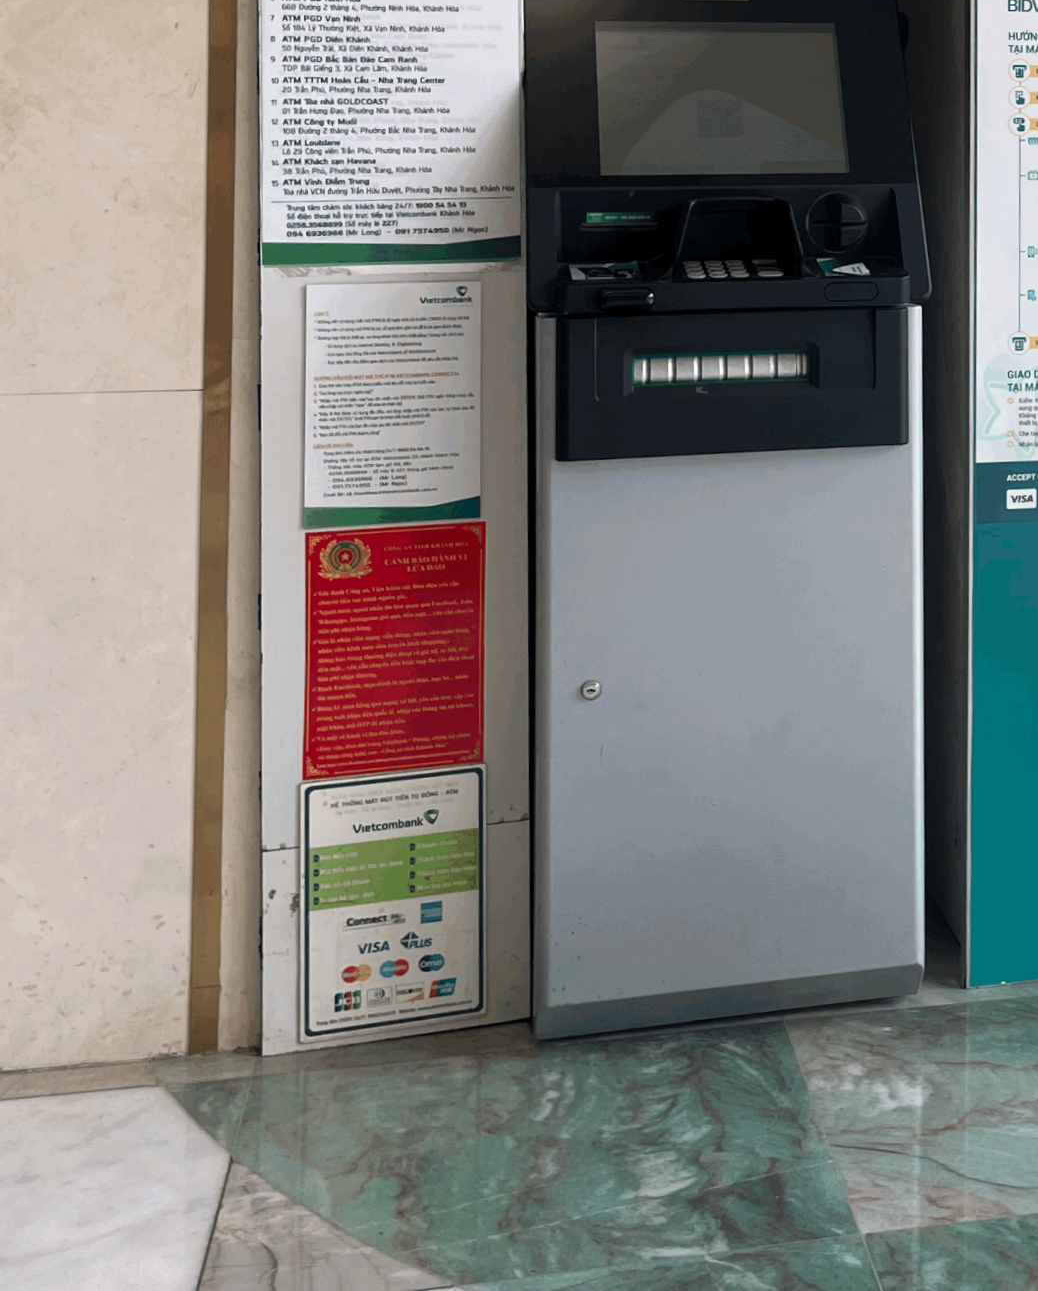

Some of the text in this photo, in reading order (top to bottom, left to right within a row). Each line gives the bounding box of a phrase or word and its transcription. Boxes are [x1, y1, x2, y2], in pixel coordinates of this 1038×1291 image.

[1008, 45, 1023, 54] TẠI
[331, 76, 352, 84] Hoàn
[397, 77, 417, 85] Trang
[349, 178, 369, 187] Trung
[420, 296, 472, 304] Vietcombank
[1007, 370, 1031, 380] GIAO
[1007, 383, 1022, 394] TẠI
[1007, 473, 1035, 481] ACCEPT
[1010, 495, 1034, 504] VISA
[353, 818, 423, 834] Vietcombank
[347, 915, 387, 927] Connect
[358, 941, 390, 954] VISA
[409, 938, 432, 949] PLUS
